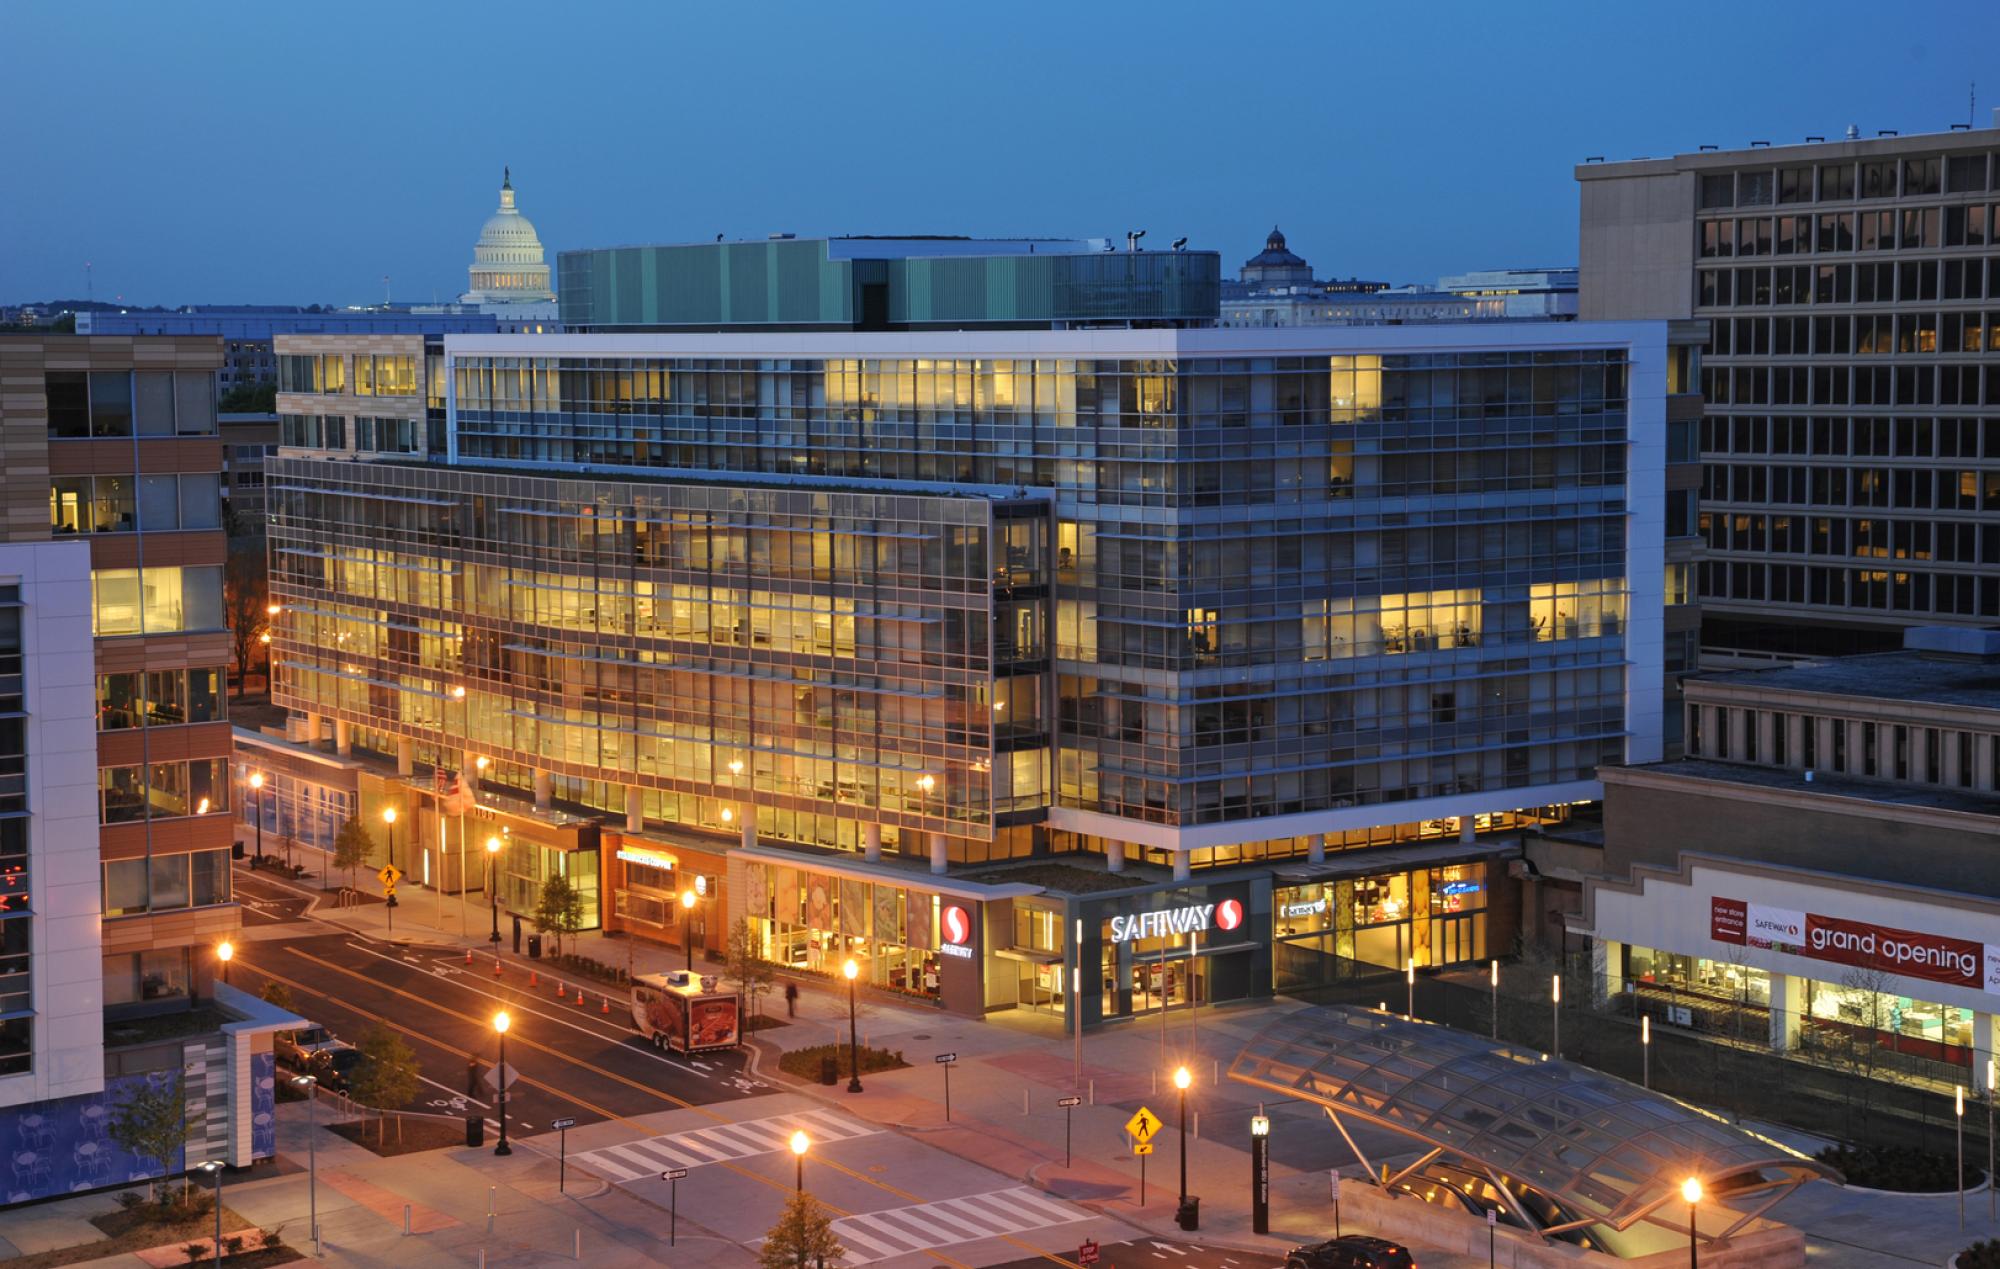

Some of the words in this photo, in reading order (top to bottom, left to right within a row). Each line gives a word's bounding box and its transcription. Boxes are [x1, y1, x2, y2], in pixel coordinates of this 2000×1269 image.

[1755, 919, 1787, 932] SAFEWAY
[1811, 927, 1876, 954] grand
[1882, 940, 1976, 977] opening
